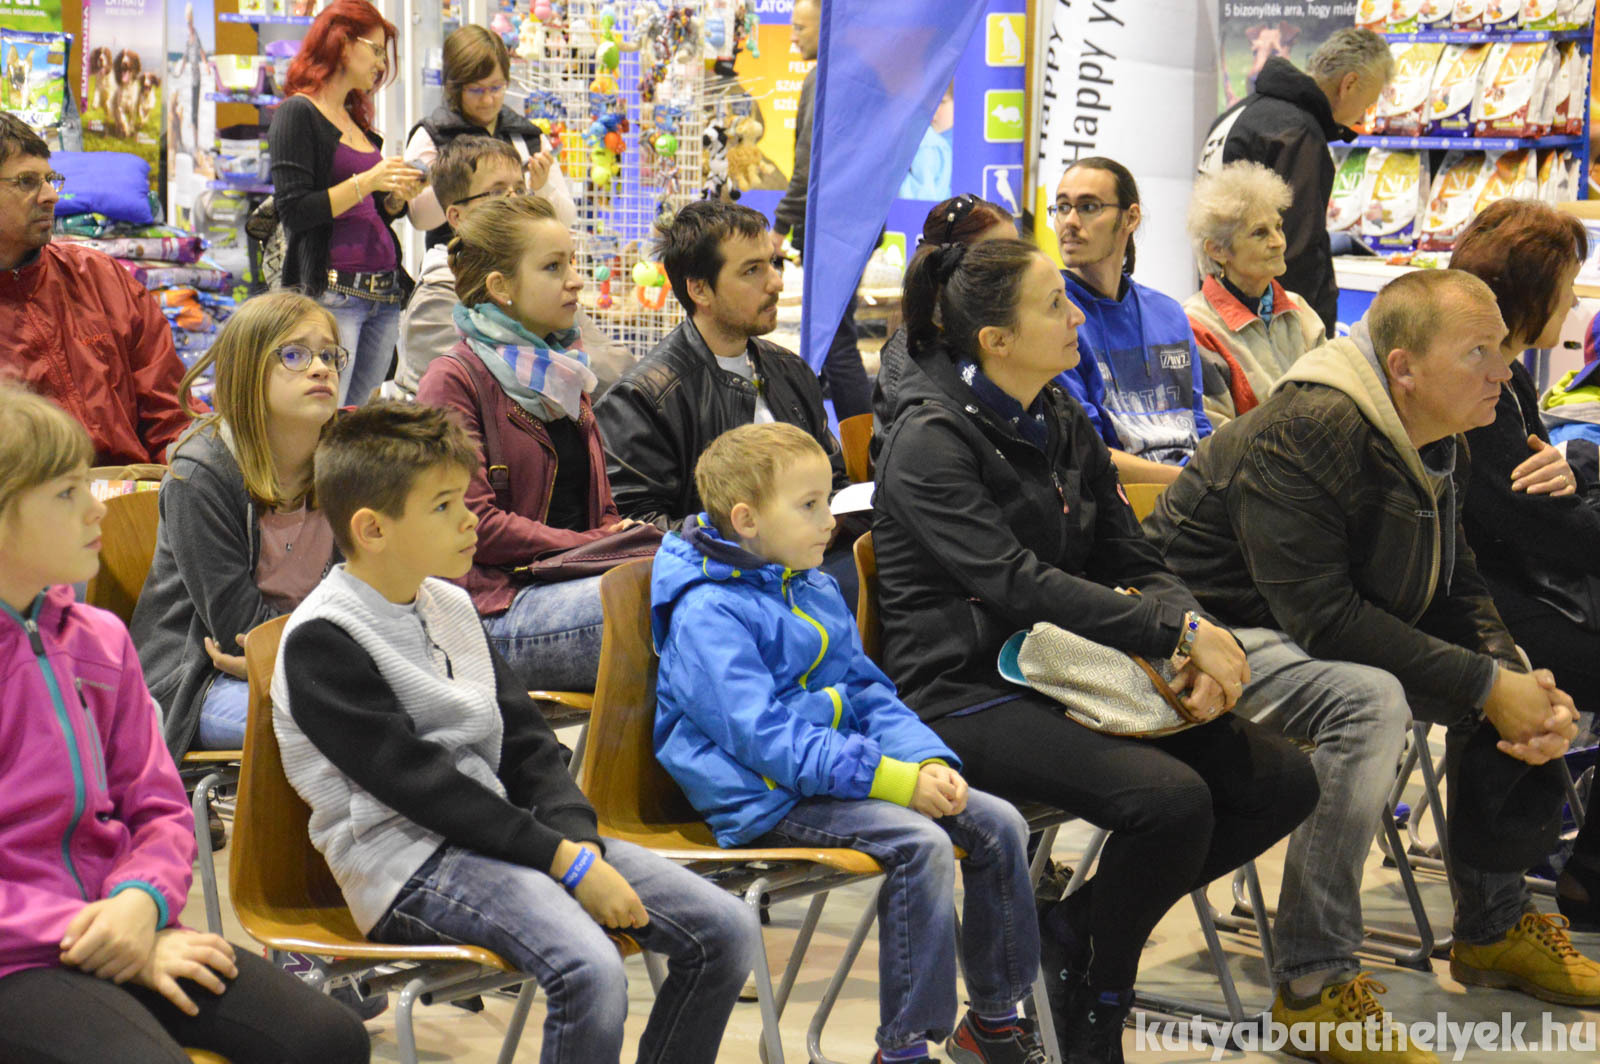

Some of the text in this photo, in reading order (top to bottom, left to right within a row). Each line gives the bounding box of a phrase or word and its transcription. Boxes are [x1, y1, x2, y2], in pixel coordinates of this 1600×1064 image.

[81, 5, 89, 98] EUKANUBA
[1225, 3, 1357, 18] 5 bizonyíték arra, hogy miér
[1061, 38, 1117, 164] Happy
